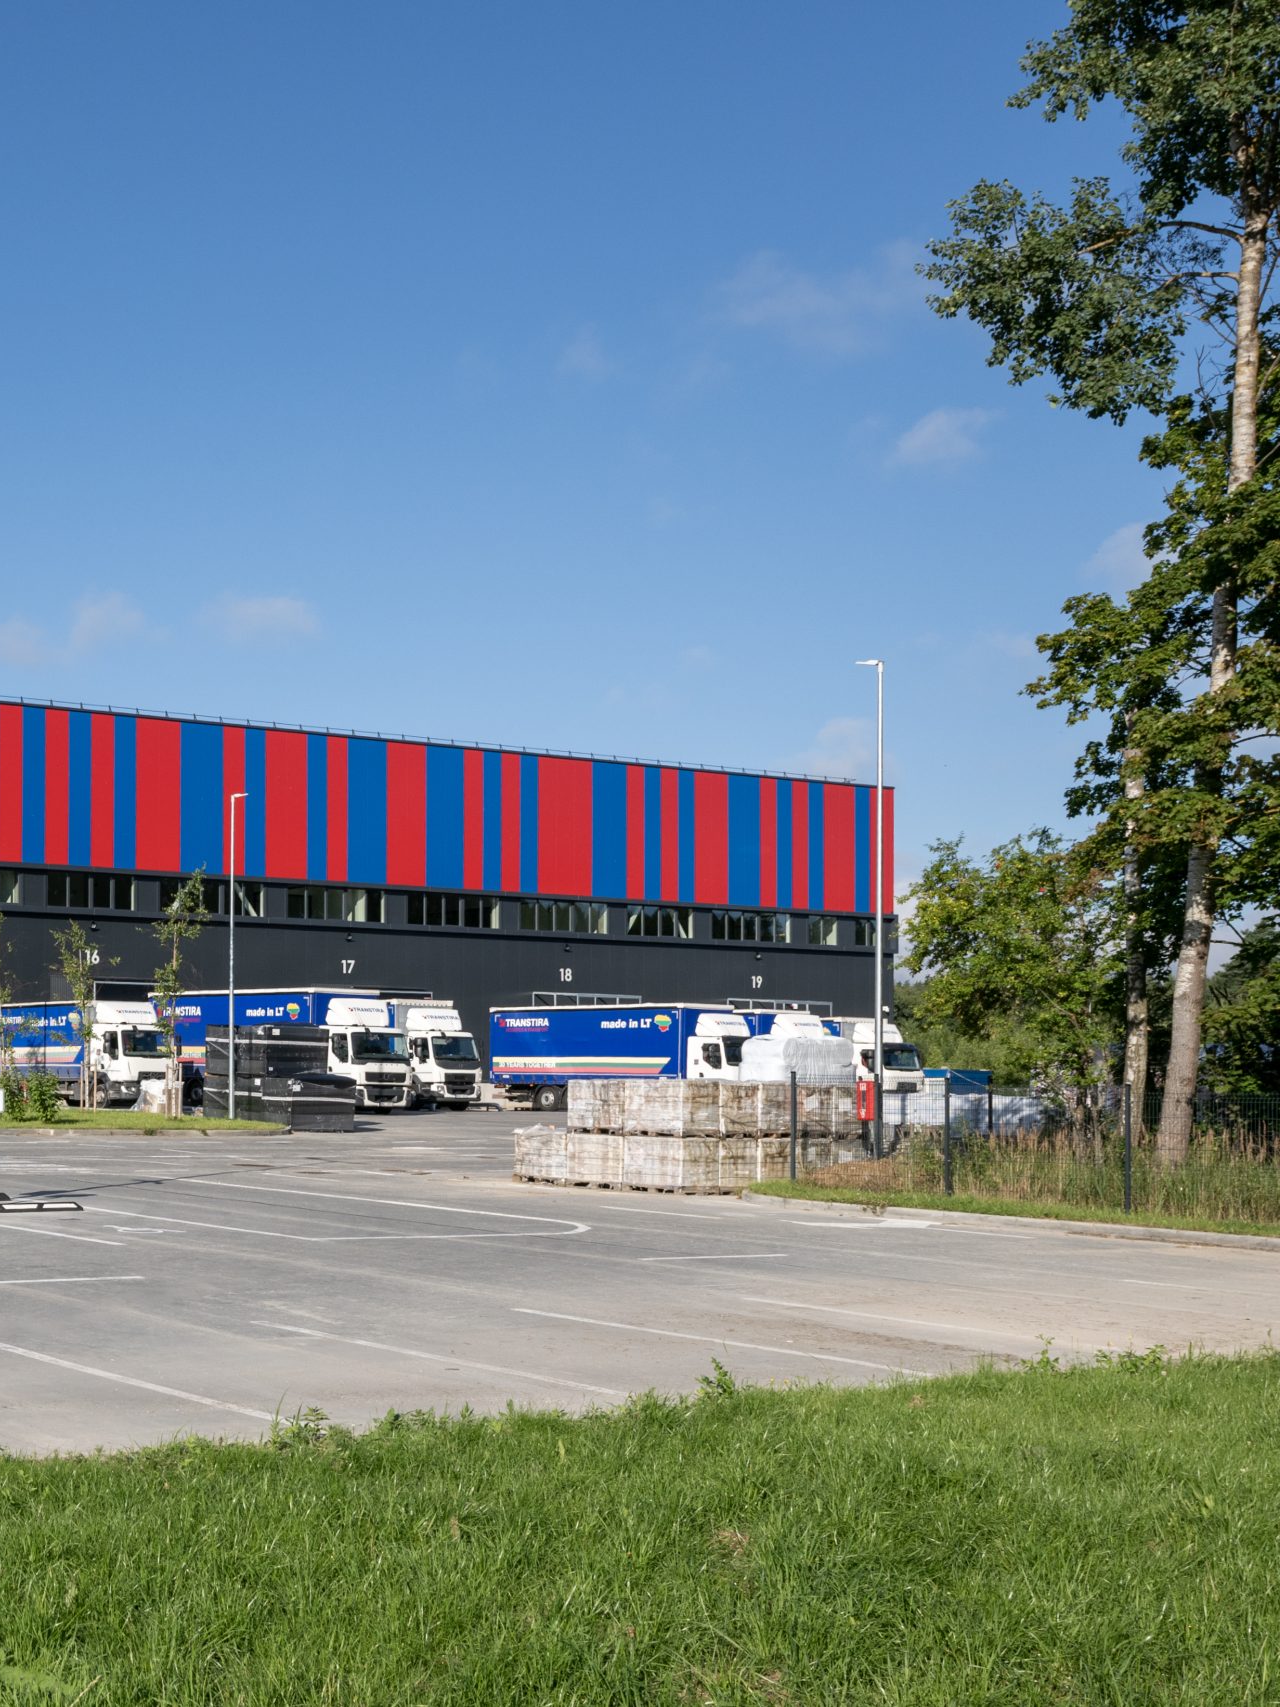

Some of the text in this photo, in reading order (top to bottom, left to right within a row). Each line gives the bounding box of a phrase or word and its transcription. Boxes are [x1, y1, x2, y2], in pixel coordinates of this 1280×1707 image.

[85, 949, 100, 966] 16
[340, 959, 355, 974] 17
[559, 967, 573, 982] 18
[751, 975, 763, 989] 19
[162, 1005, 202, 1017] TRNSTIRA
[245, 1006, 285, 1017] made in LT
[505, 1017, 550, 1027] TRANSTIRA
[600, 1018, 652, 1029] made in LT
